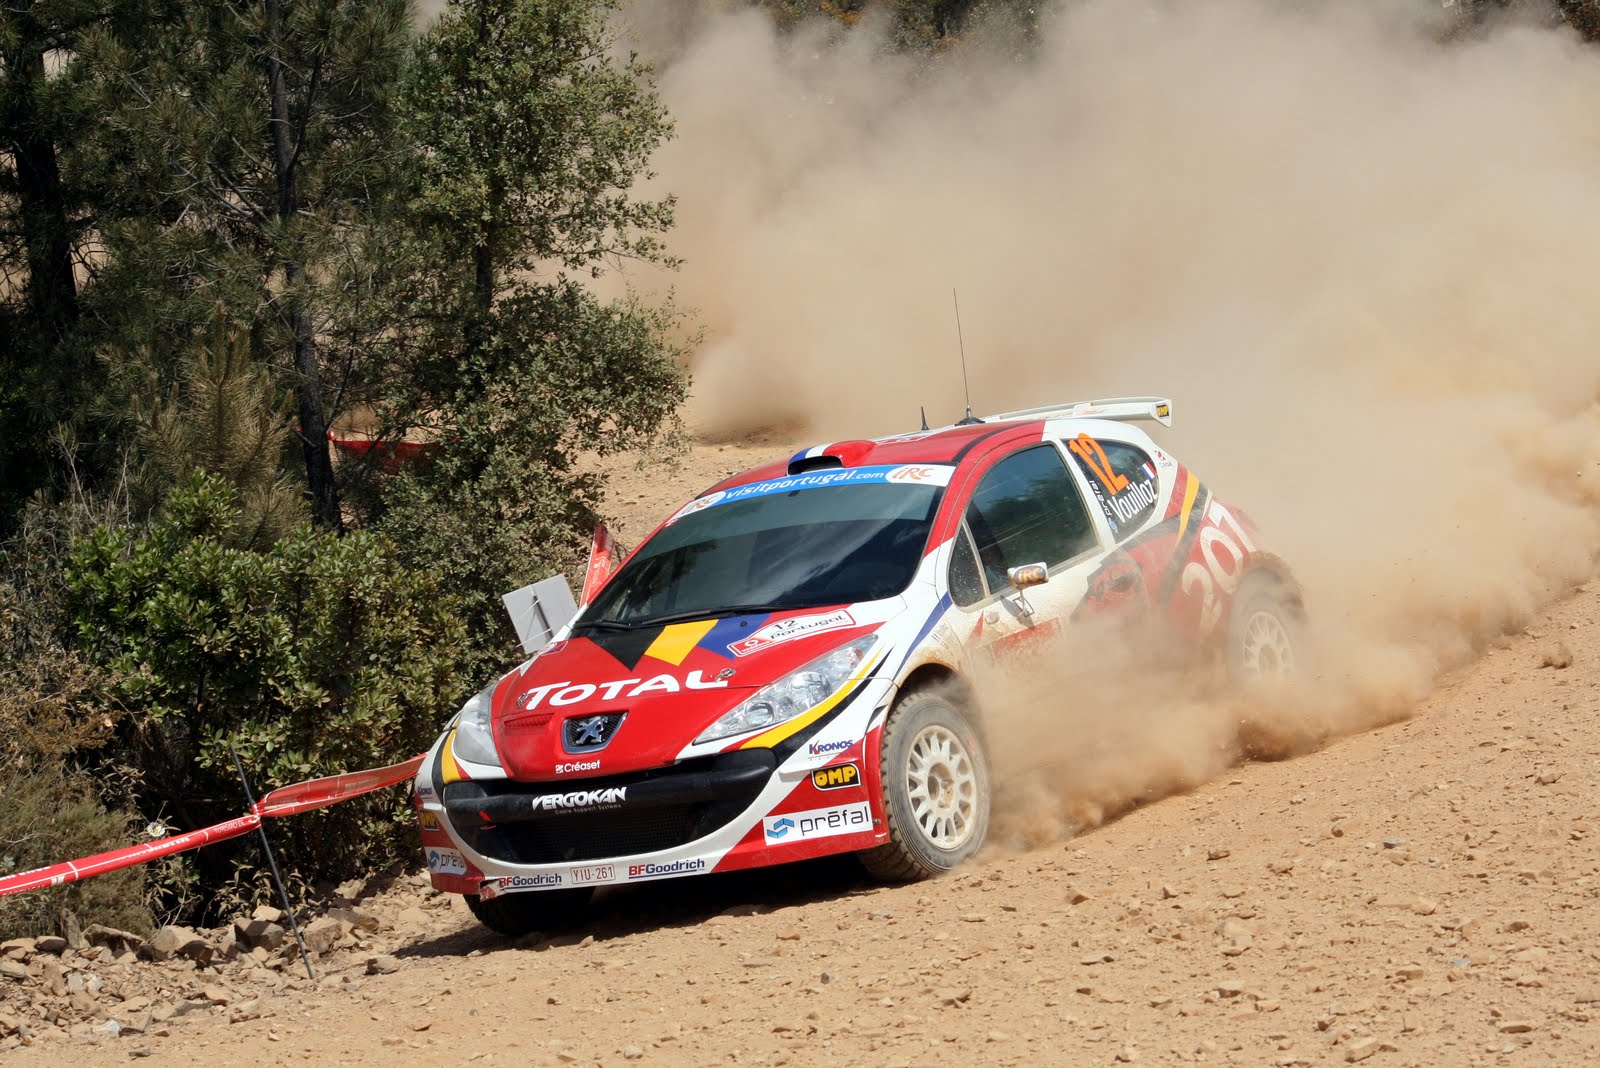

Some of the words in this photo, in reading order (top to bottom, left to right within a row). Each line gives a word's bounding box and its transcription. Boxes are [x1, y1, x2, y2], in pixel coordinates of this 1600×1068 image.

[1068, 433, 1130, 495] 12
[727, 470, 884, 499] visitportugal.com
[1107, 479, 1158, 523] Vouilloz
[1182, 499, 1257, 645] 207
[770, 615, 847, 639] Portugal
[773, 619, 799, 630] 12
[526, 669, 729, 710] TOTAL
[808, 739, 853, 755] KRONOS
[563, 760, 601, 773] Créaset
[815, 765, 856, 787] OMP
[532, 786, 627, 811] VERGOKAN
[573, 866, 614, 882] YIU-261
[628, 858, 705, 876] BFGoodrich
[499, 873, 562, 888] BFGoodrich
